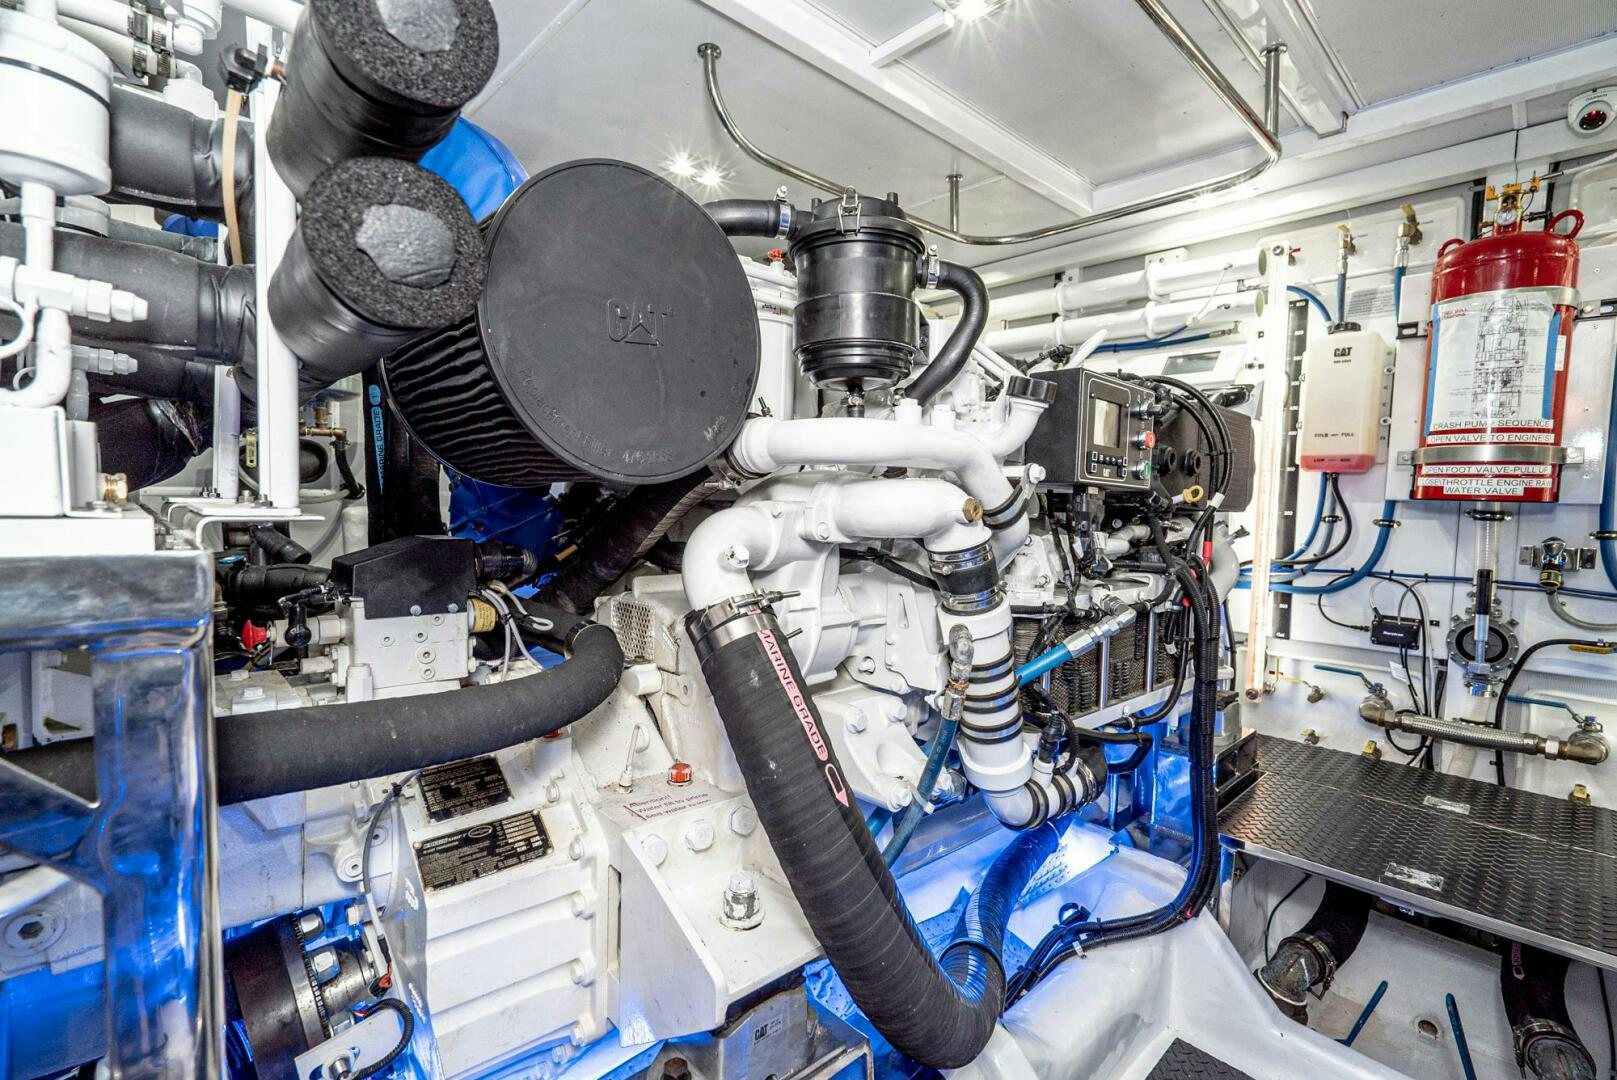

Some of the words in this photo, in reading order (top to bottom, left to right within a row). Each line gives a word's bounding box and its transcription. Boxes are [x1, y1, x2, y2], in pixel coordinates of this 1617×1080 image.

[606, 299, 670, 346] CAT
[1333, 346, 1353, 357] CAT
[1433, 420, 1461, 429] CRASH
[1497, 419, 1550, 428] SEQUENCE
[1430, 435, 1452, 443] OPEN
[1453, 434, 1486, 442] VALVE
[1424, 466, 1444, 474] OPEN
[1496, 479, 1533, 487] ENGINE
[1445, 486, 1480, 494] WATER
[1483, 487, 1518, 495] VALVE
[793, 694, 827, 756] GRADE
[754, 1023, 769, 1041] CAT
